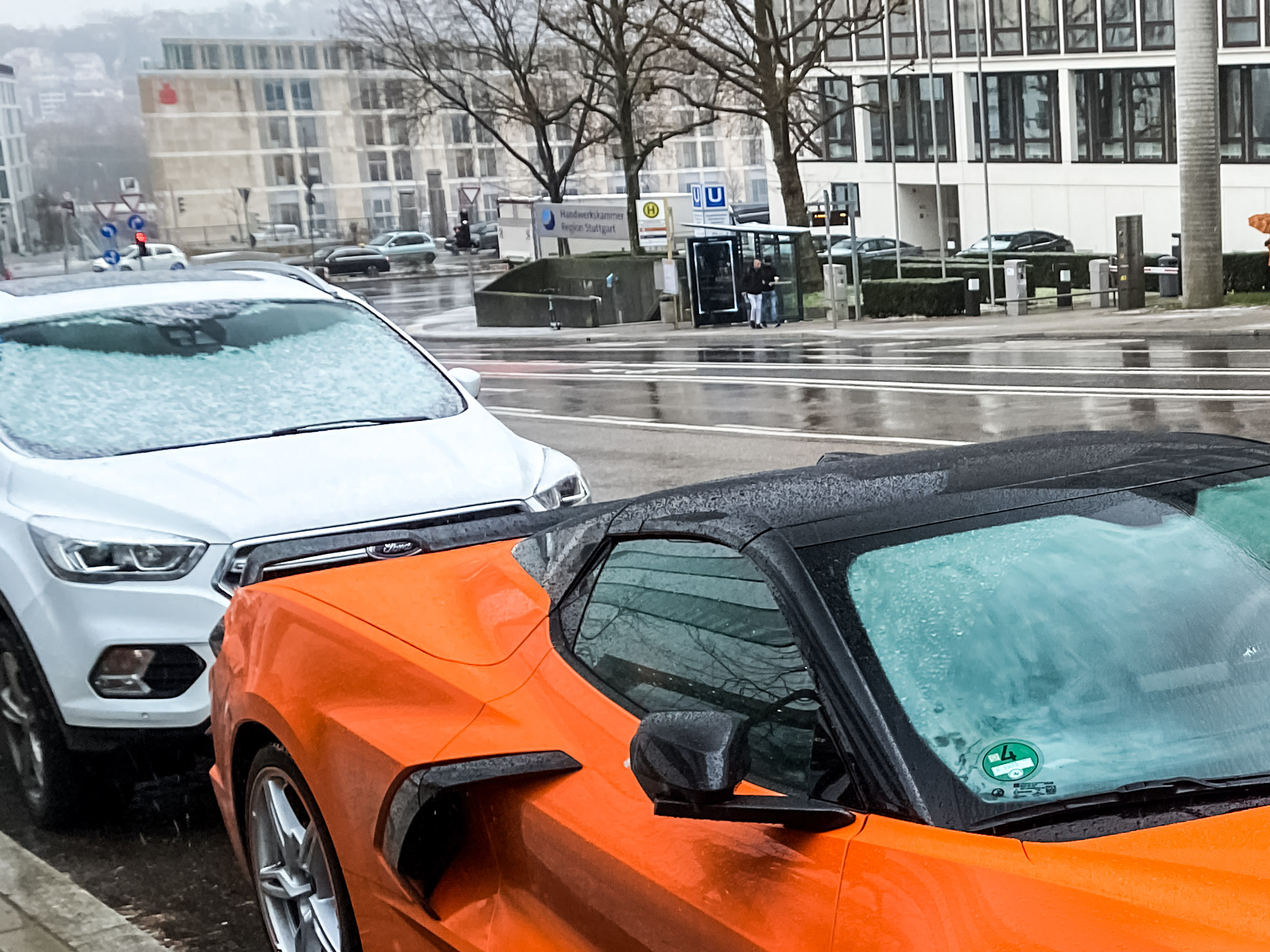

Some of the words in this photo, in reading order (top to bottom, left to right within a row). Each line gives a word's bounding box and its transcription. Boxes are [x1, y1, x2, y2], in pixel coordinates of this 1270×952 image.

[693, 187, 700, 203] U
[707, 187, 722, 203] U
[560, 208, 624, 220] Handwerkskammer
[646, 205, 656, 215] H
[561, 223, 584, 234] Region
[585, 223, 616, 235] Stuttgart
[1001, 745, 1017, 761] 4
